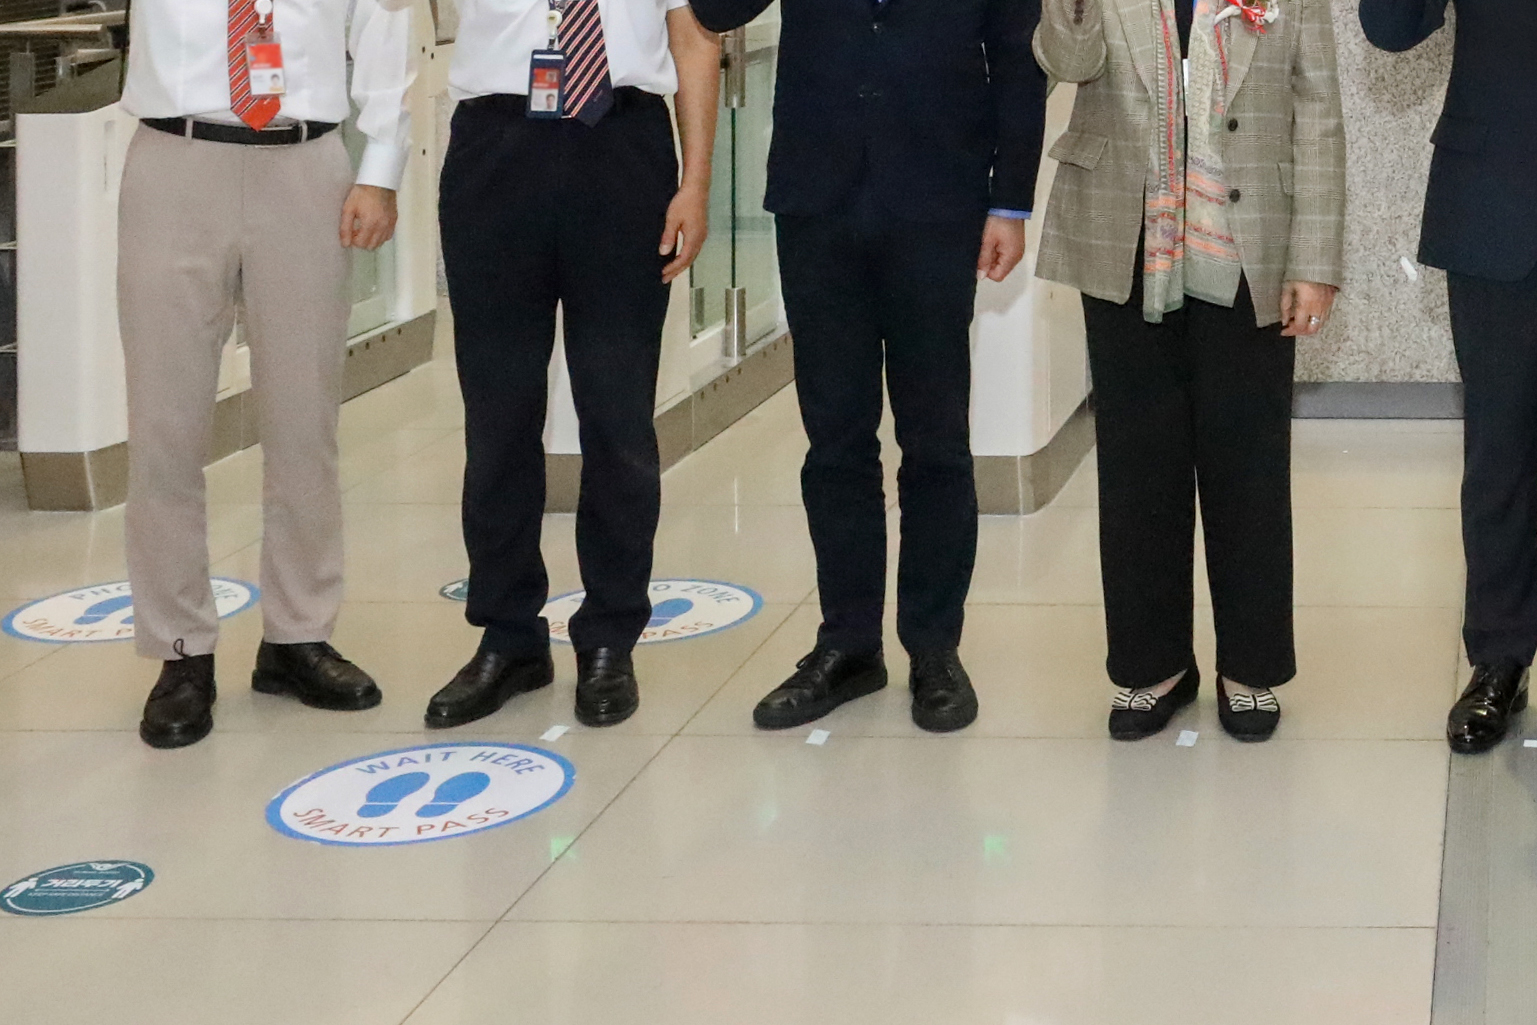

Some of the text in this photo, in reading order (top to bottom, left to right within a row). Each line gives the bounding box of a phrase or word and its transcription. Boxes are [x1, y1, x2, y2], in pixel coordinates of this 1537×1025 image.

[681, 584, 741, 604] ZONE
[22, 617, 99, 638] SMART
[642, 621, 715, 639] PASS
[356, 750, 546, 776] WAIT HERE
[293, 806, 511, 839] SMART PASS
